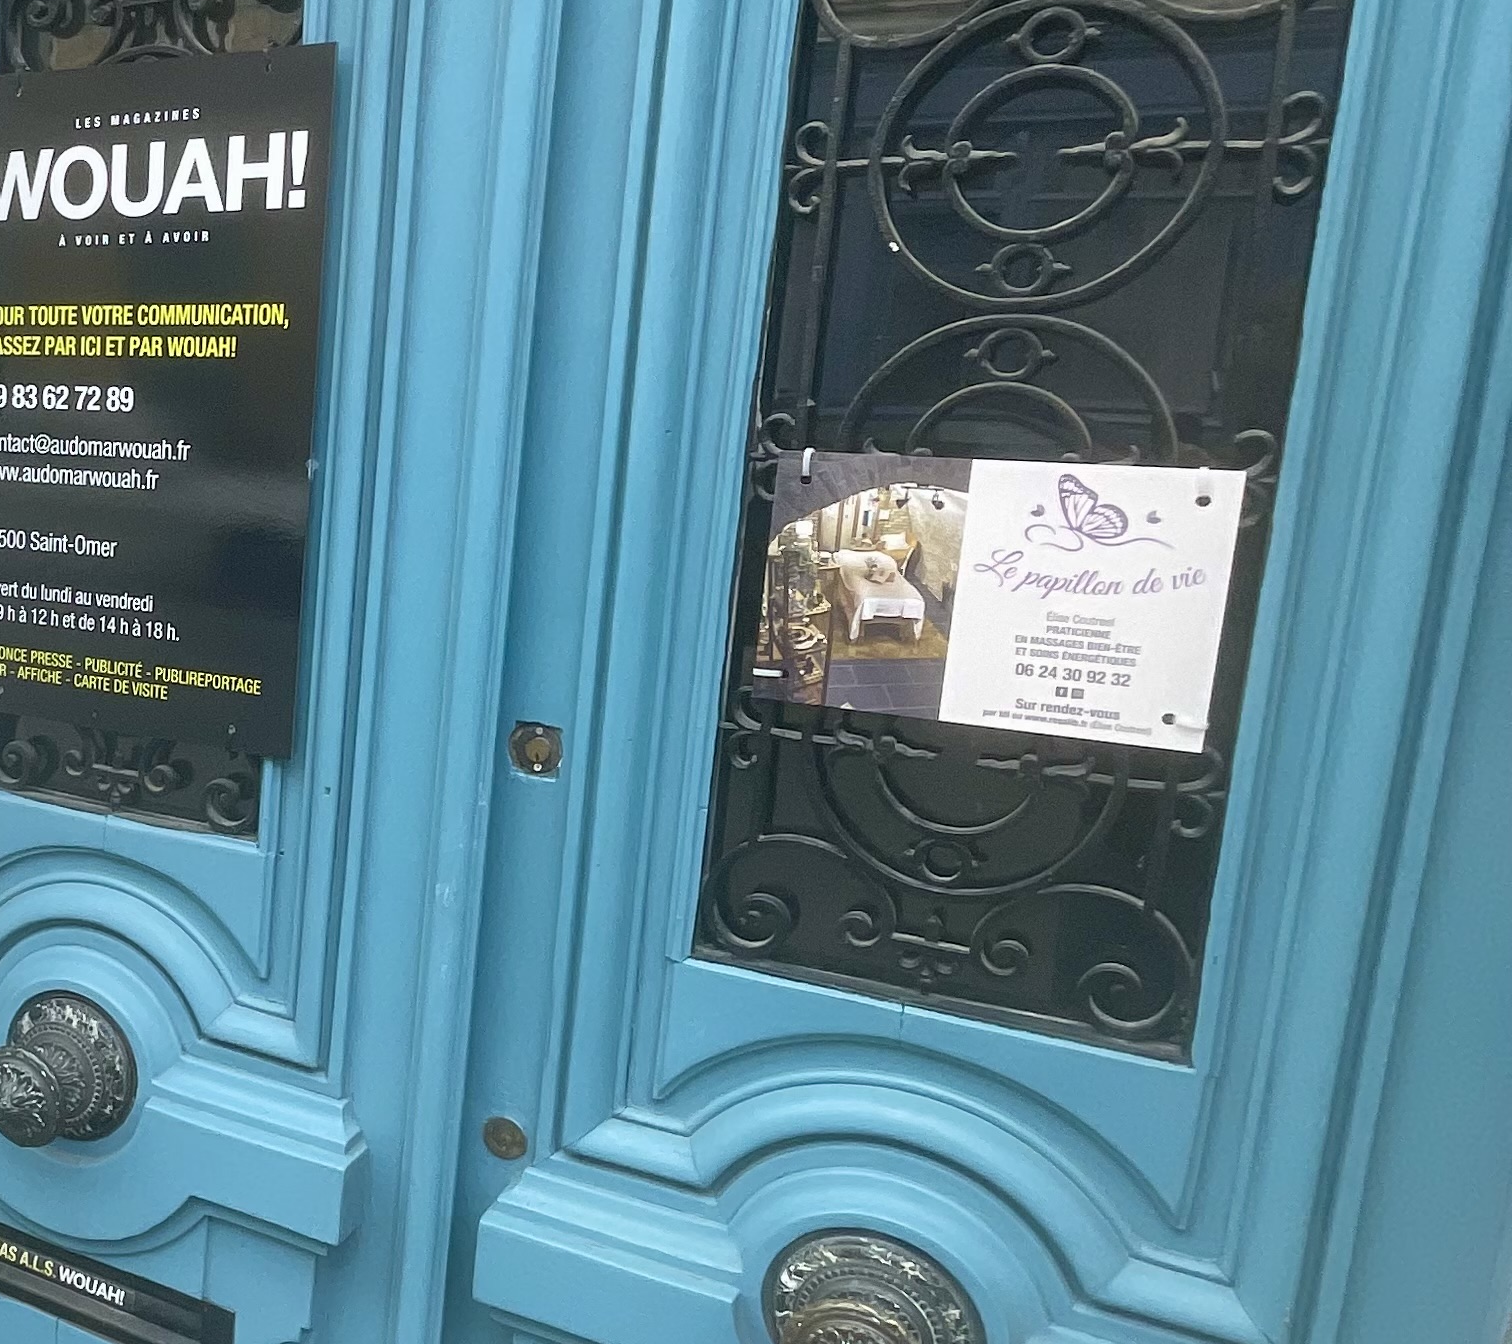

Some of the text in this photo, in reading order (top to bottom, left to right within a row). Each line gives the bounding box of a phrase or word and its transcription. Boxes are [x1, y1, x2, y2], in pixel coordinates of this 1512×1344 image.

[75, 107, 201, 129] LES MAGAZINES
[58, 230, 210, 247] À VOIR ET À AVOIR
[28, 305, 78, 326] TOUTE
[81, 305, 133, 326] VOTRE
[137, 303, 289, 329] COMMUNICATION,
[45, 336, 77, 356] PAR
[80, 336, 101, 356] ICI
[105, 336, 126, 357] ET
[129, 336, 163, 357] PAR
[167, 336, 237, 358] WOUAH!
[11, 384, 38, 410] 83
[42, 385, 69, 410] 62
[74, 386, 101, 411] 72
[106, 386, 134, 412] 89
[29, 532, 118, 558] Saint-Omer
[973, 549, 1206, 600] Le papillon de vie
[21, 582, 37, 600] du
[40, 584, 72, 605] lundi
[74, 591, 92, 606] au
[95, 591, 153, 613] vendredi
[7, 605, 16, 622] h
[19, 606, 28, 623] à
[31, 608, 48, 626] 12
[50, 609, 59, 627] h
[62, 612, 76, 629] et
[78, 613, 95, 631] de
[99, 616, 116, 634] 14
[119, 618, 129, 636] h
[132, 618, 142, 638] à
[145, 621, 163, 640] 18
[166, 623, 180, 642] h.
[1046, 626, 1111, 639] PRATICIENNE
[1015, 635, 1027, 644] EN
[1030, 636, 1085, 650] MASSAGES
[1015, 647, 1027, 656] ET
[18, 666, 62, 685] AFFICHE
[74, 674, 110, 692] CARTE
[113, 678, 129, 695] DE
[132, 681, 168, 700] VISITE
[30, 650, 73, 669] PRESSE
[85, 657, 143, 678] PUBLICITÉ
[155, 667, 262, 695] PUBLIREPORTAGE
[1015, 662, 1131, 687] 06 24 30 92 32
[1015, 698, 1120, 720] Sur rendez-vous
[19, 1250, 57, 1279] A.L.S.
[58, 1265, 126, 1306] WOUAH!
